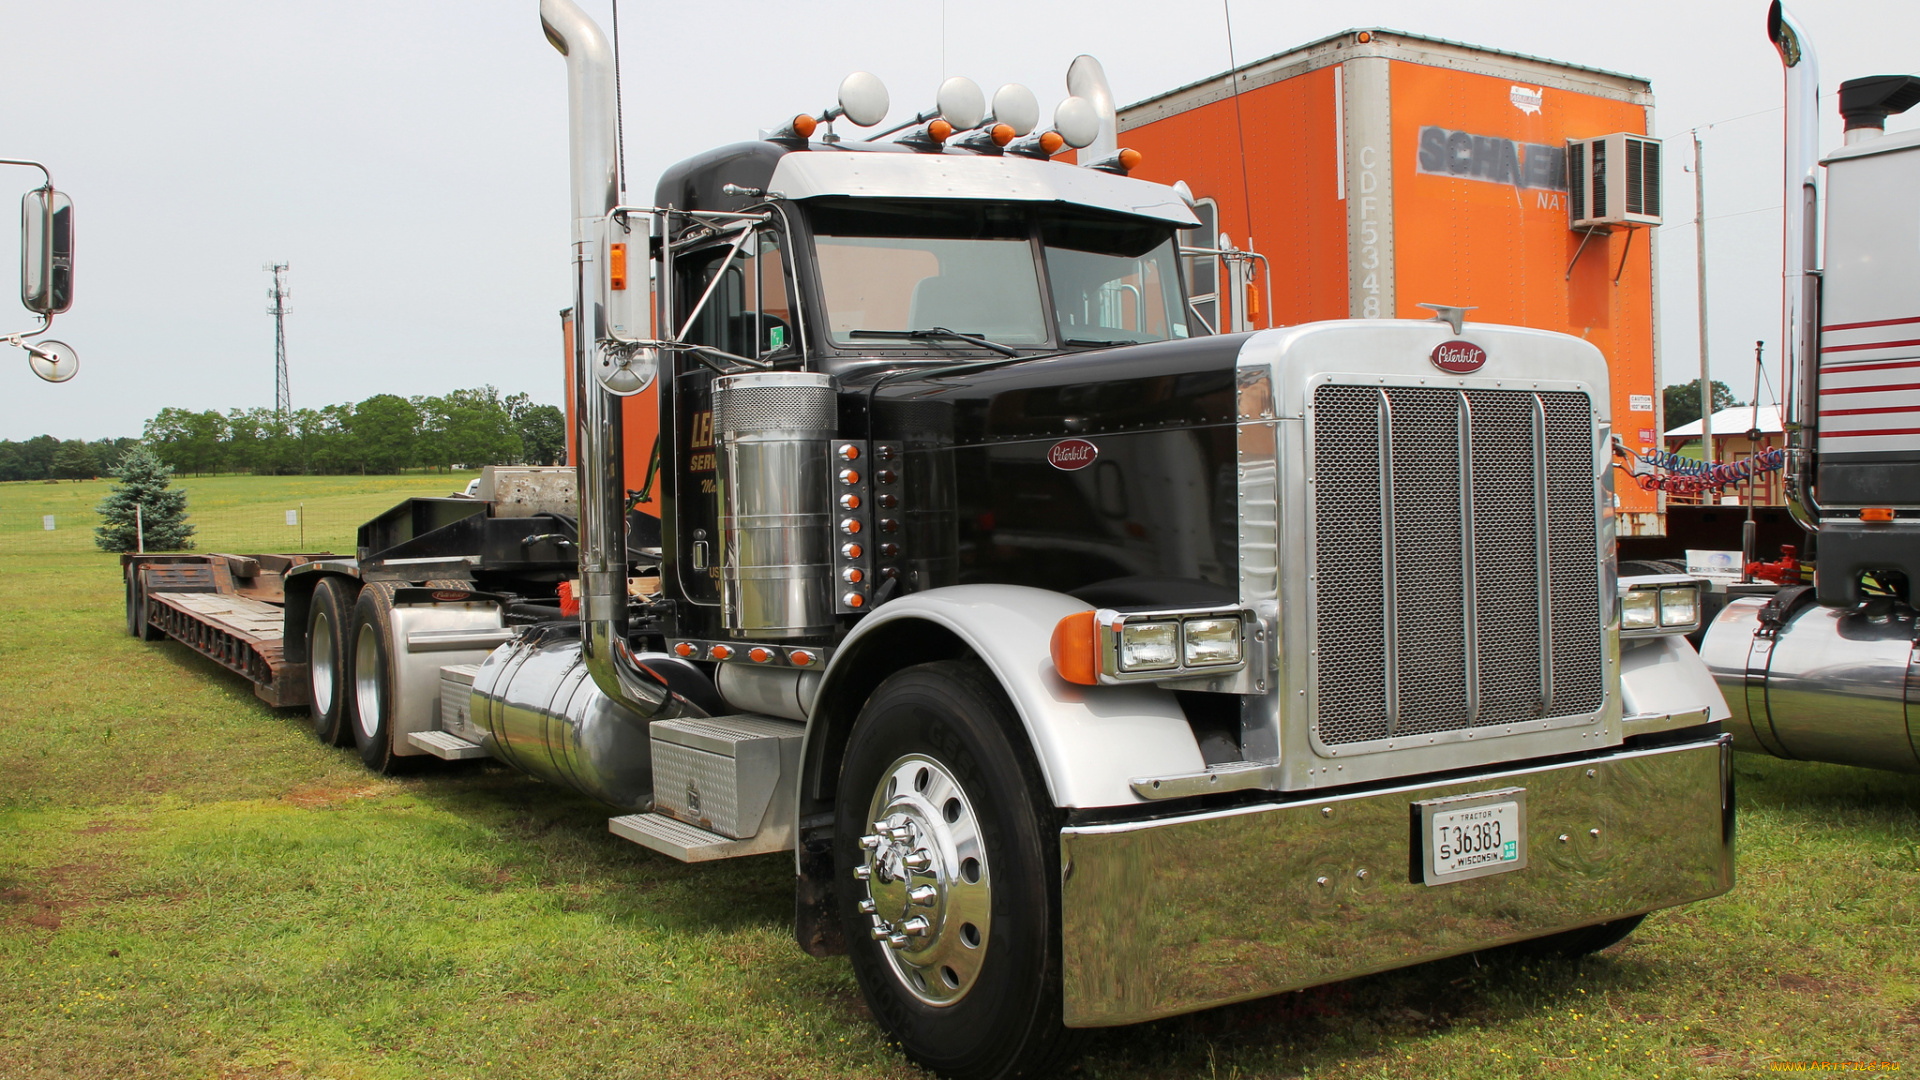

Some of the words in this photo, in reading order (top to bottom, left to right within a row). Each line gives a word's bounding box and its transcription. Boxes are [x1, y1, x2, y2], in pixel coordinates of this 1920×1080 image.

[1438, 345, 1482, 364] Peterbilt
[1053, 445, 1091, 463] Peterbilt
[1460, 811, 1492, 821] TRACTOR
[1453, 820, 1502, 855] 36383
[1457, 852, 1498, 866] WISCONSIN
